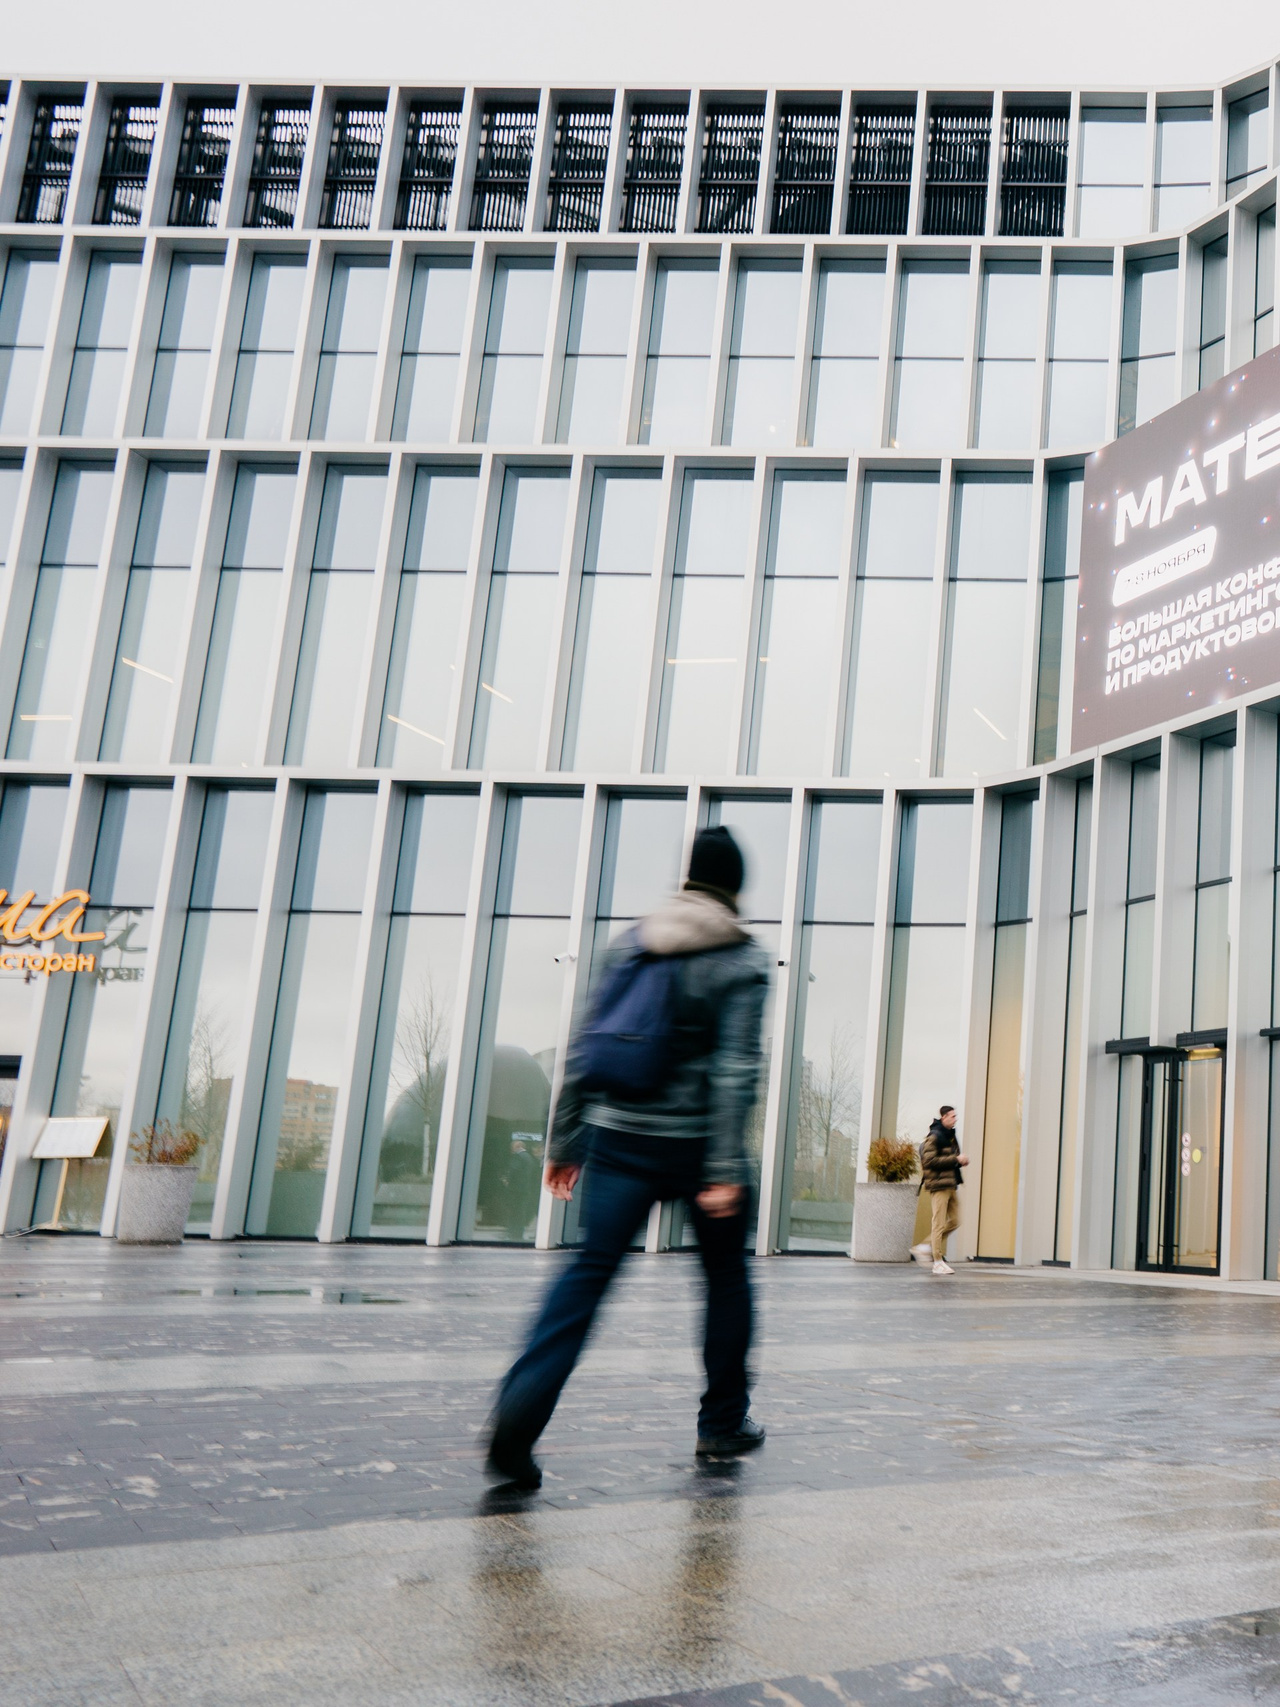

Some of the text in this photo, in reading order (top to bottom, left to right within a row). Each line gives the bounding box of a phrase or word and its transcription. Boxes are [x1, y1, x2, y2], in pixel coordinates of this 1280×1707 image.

[1146, 543, 1206, 580] НОЯБРЯ
[1108, 585, 1213, 649] БОЛЬШАЯ
[1106, 644, 1136, 673] ПО
[1104, 671, 1120, 696] И
[0, 952, 96, 977] сторан
